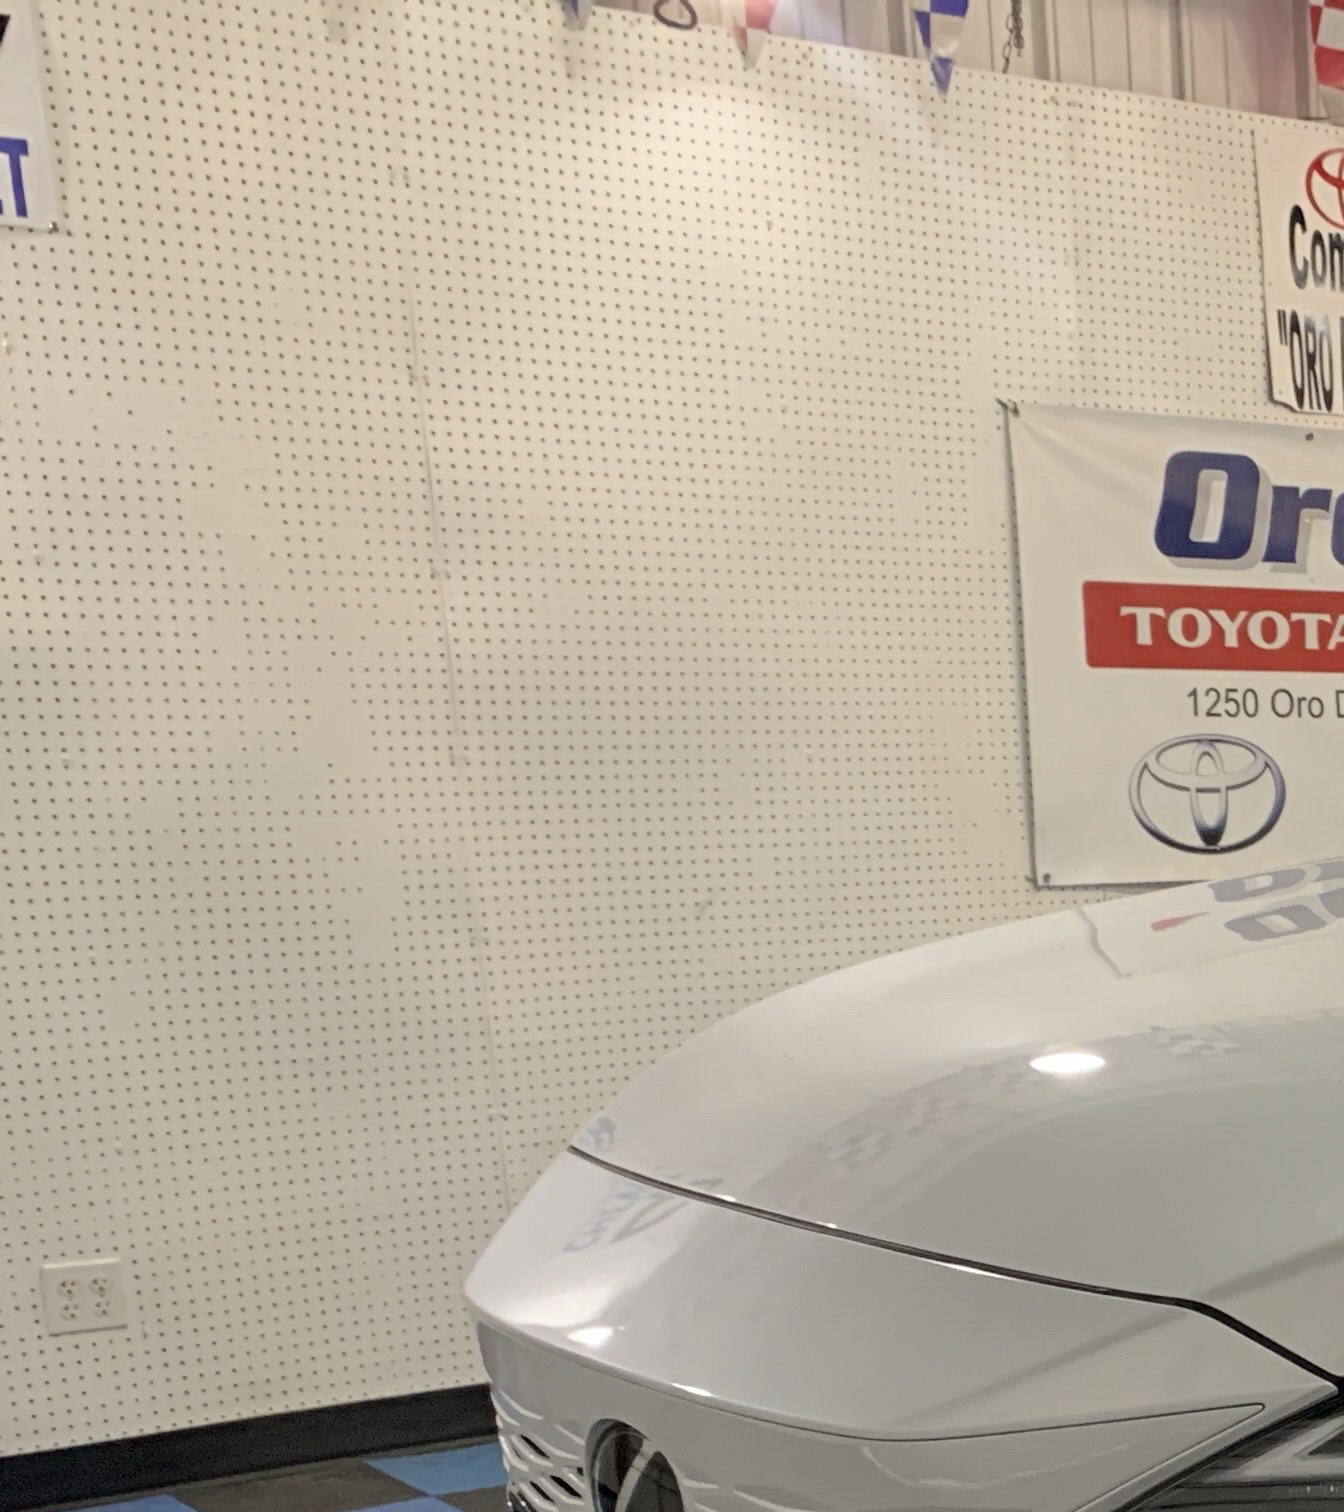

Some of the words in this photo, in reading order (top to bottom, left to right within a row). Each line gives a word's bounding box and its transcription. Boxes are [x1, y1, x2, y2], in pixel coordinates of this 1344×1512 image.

[1277, 309, 1334, 413] "ORO
[1186, 687, 1259, 719] 1250
[1271, 688, 1325, 721] Oro
